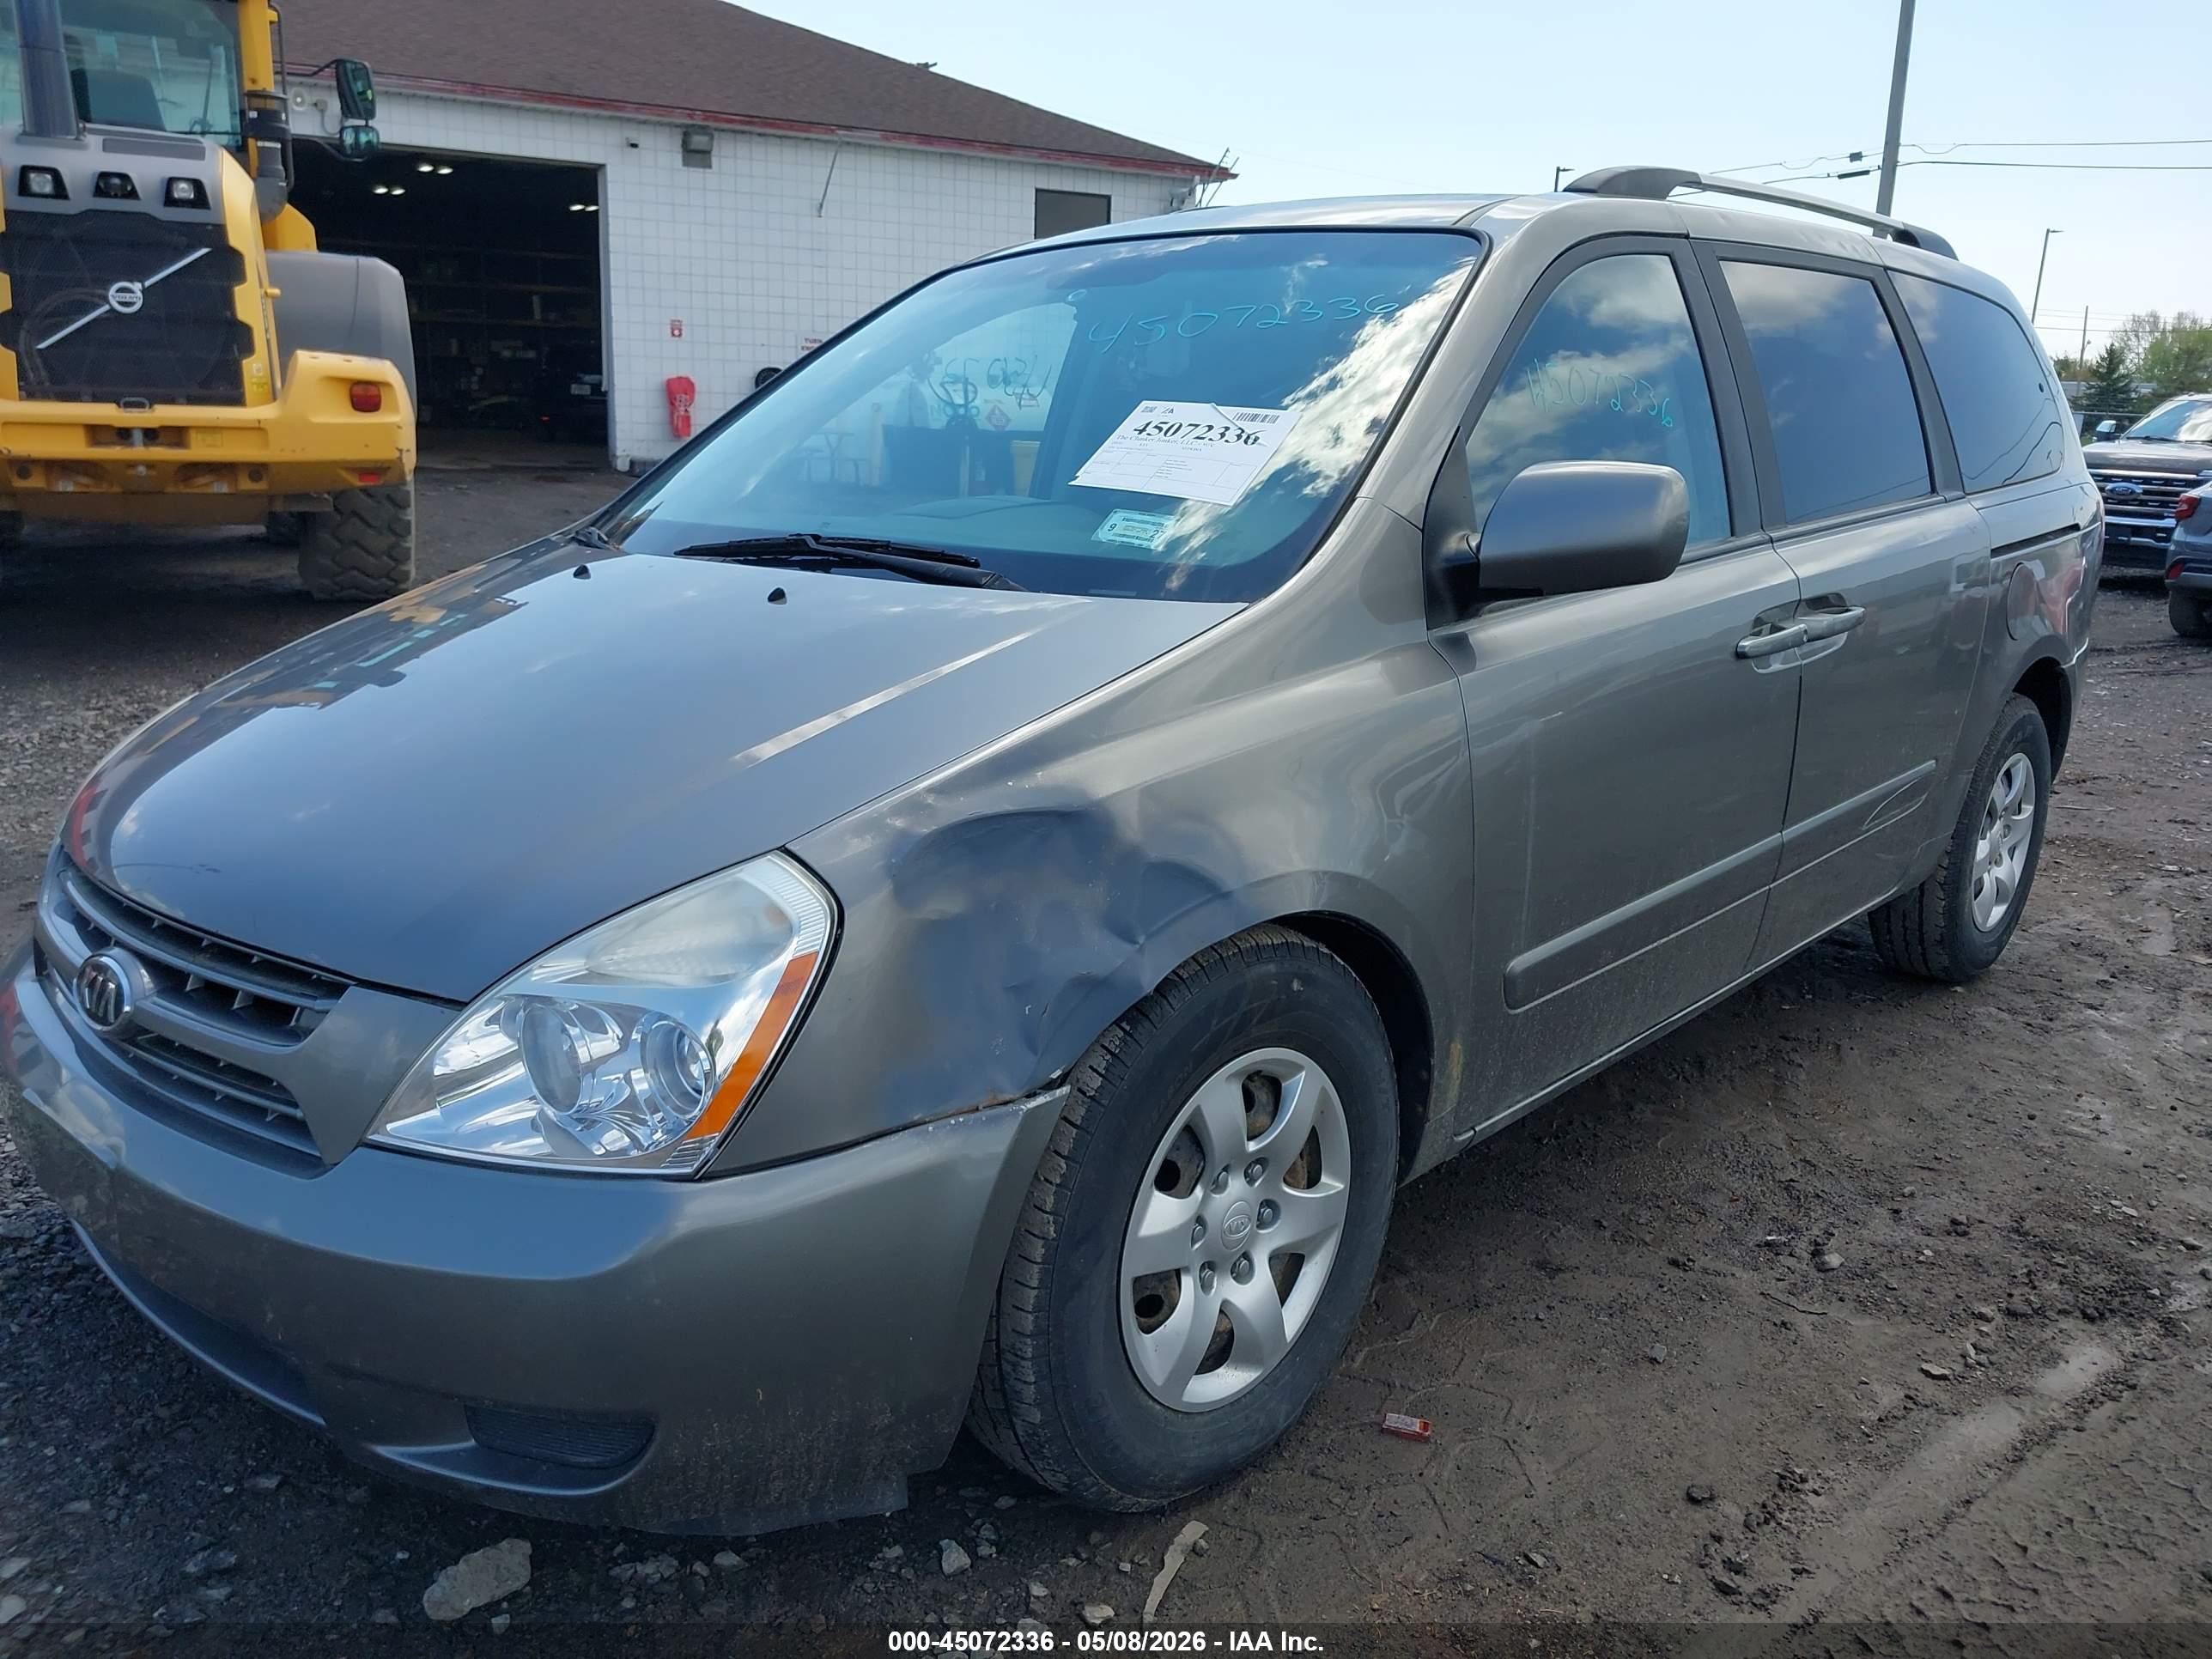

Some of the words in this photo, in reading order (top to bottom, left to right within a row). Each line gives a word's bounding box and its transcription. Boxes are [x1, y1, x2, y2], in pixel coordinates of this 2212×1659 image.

[1088, 294, 1400, 354] 45072336
[1133, 420, 1262, 446] 45072336
[1108, 522, 1117, 532] 9
